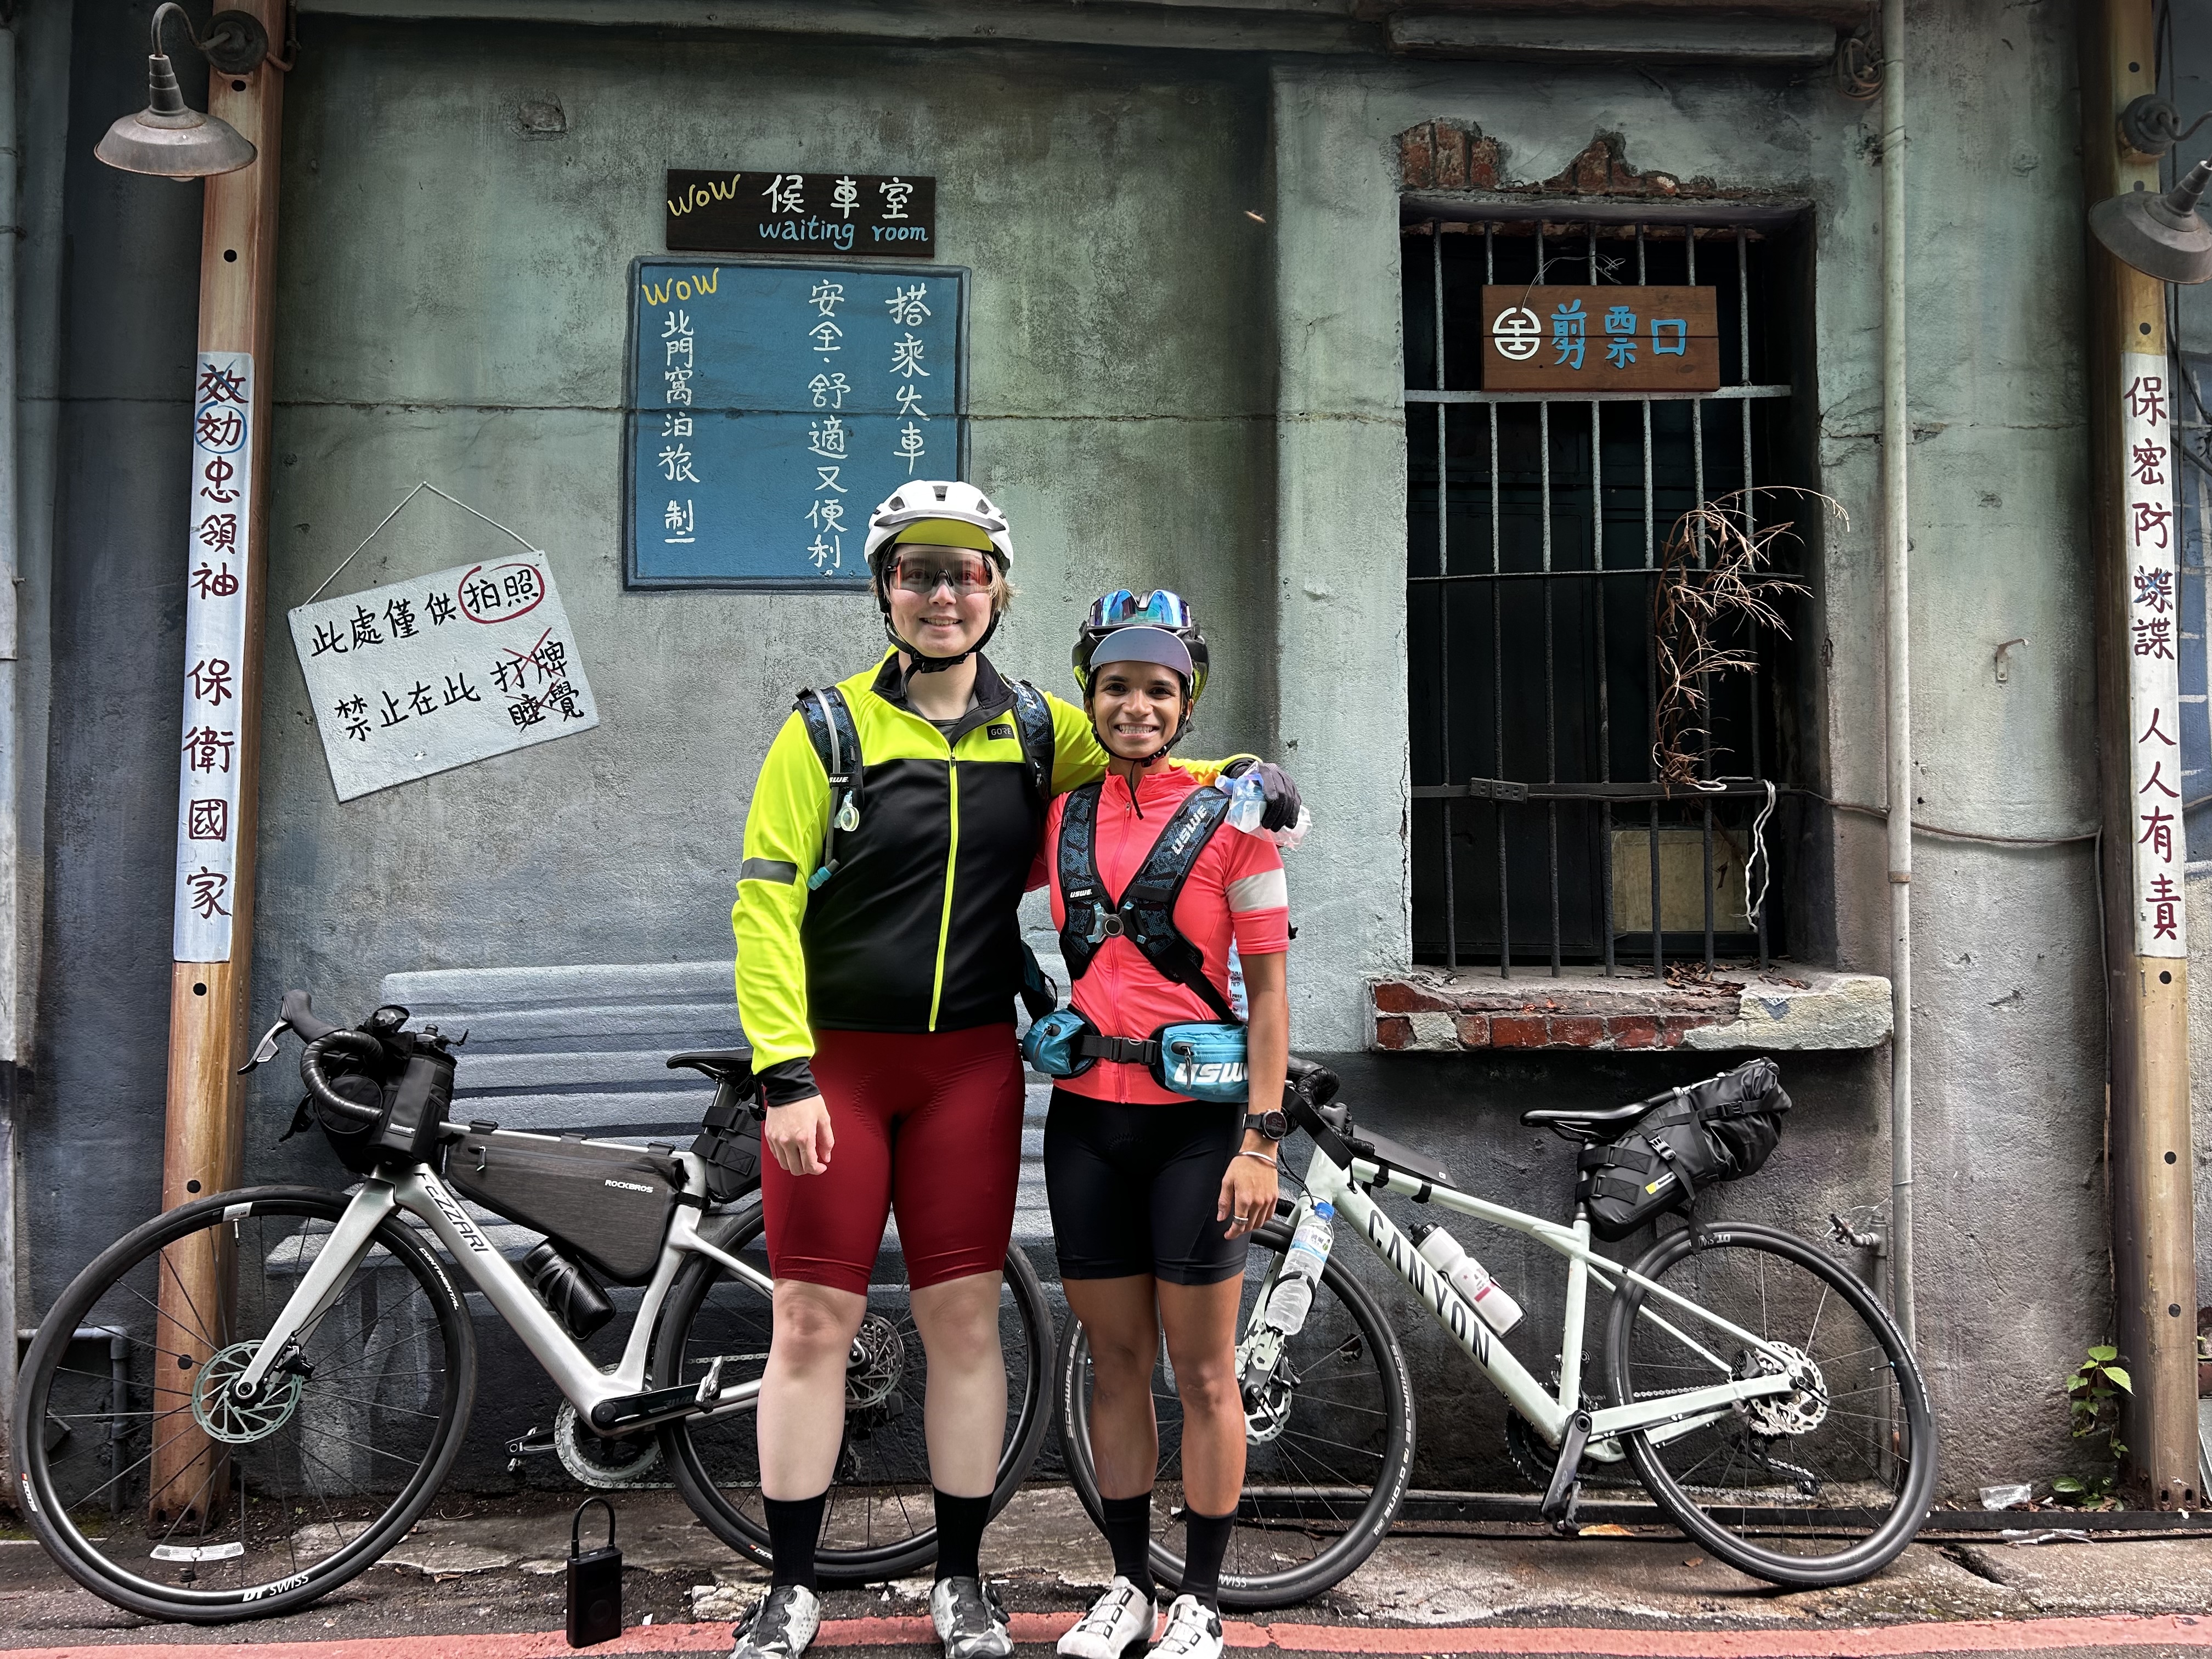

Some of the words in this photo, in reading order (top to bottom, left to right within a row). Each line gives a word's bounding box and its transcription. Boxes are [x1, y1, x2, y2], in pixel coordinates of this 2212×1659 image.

[762, 174, 913, 219] 候車室
[759, 215, 855, 250] waiting
[872, 225, 928, 241] room
[1551, 299, 1687, 370] 剪票口
[991, 727, 1012, 736] GORE
[1171, 805, 1207, 855] USWE
[1070, 889, 1092, 898] USWE
[605, 1180, 654, 1193] ROCKBROS
[413, 1172, 490, 1252] FEZZARI
[419, 1248, 460, 1311] CONTINENTAL
[1368, 1209, 1489, 1369] CANYON
[1064, 1333, 1079, 1438] SCHWALBE
[1390, 1344, 1412, 1444] SCHWALBE
[269, 1573, 309, 1596] SWISS
[1218, 1573, 1246, 1588] WISS
